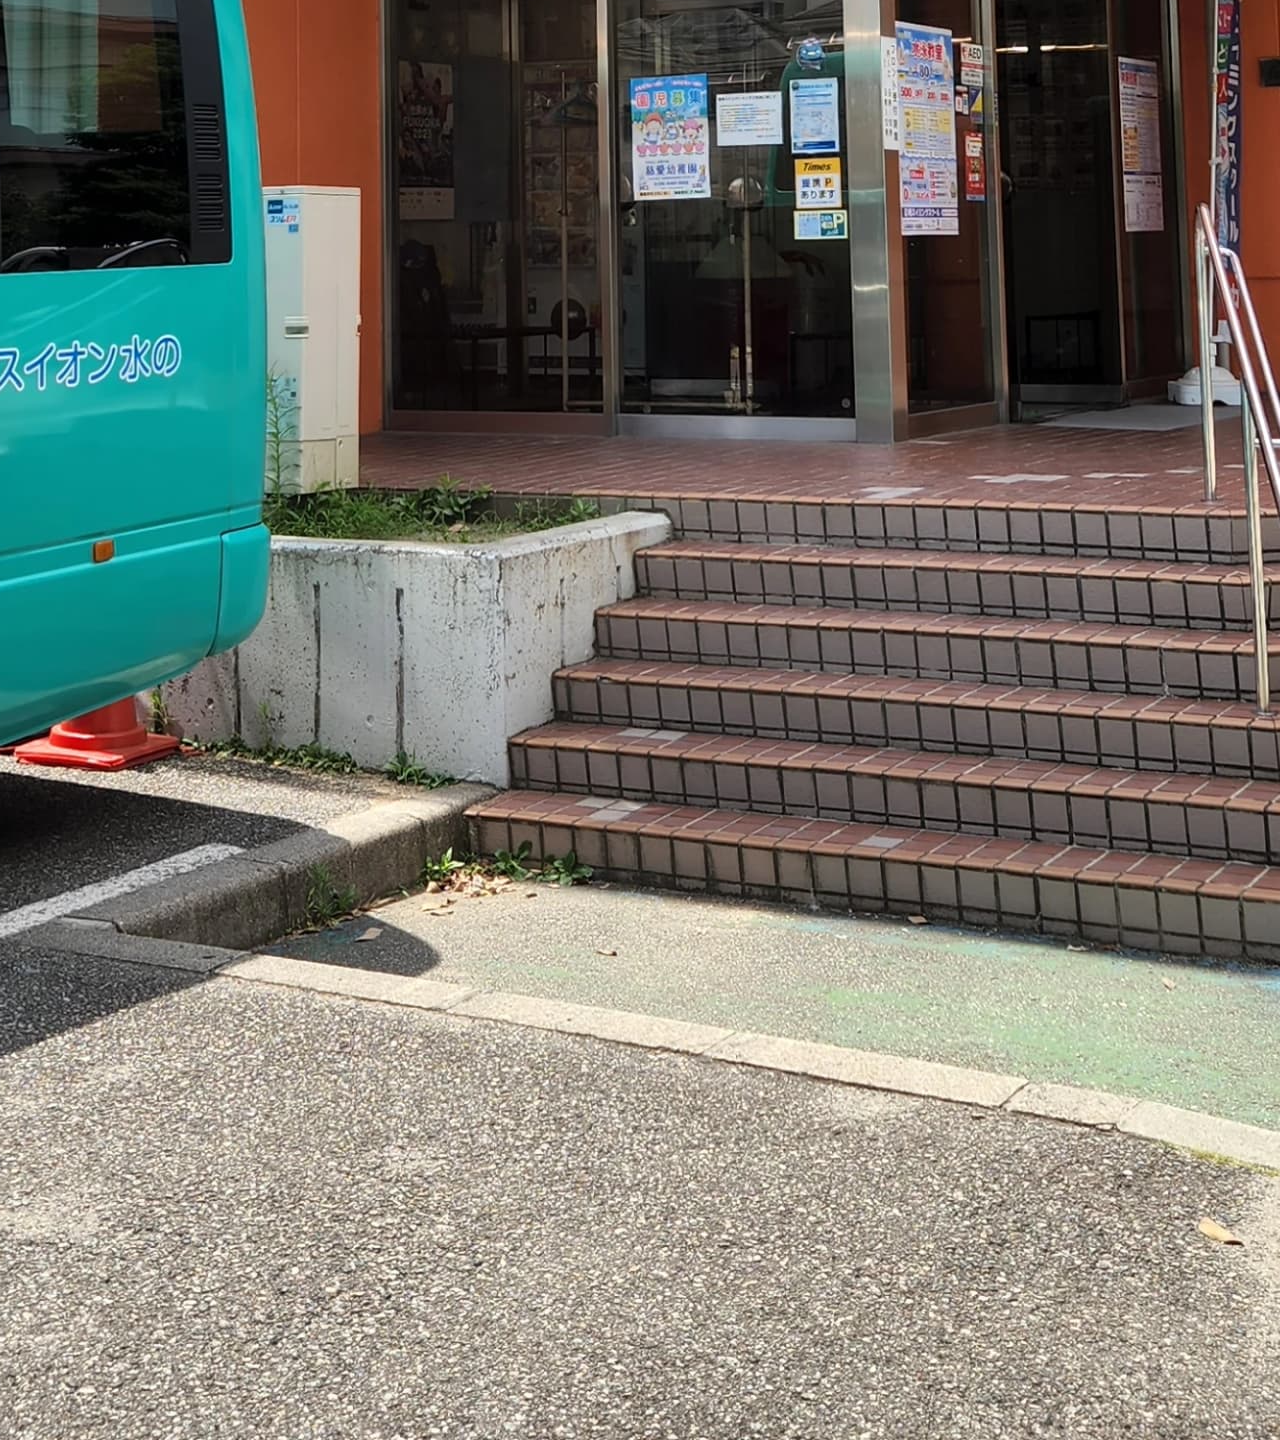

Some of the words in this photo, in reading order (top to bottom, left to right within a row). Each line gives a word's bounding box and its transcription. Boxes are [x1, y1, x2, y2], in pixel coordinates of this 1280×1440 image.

[967, 47, 981, 60] AED
[803, 162, 832, 172] Times
[801, 190, 836, 200] あります
